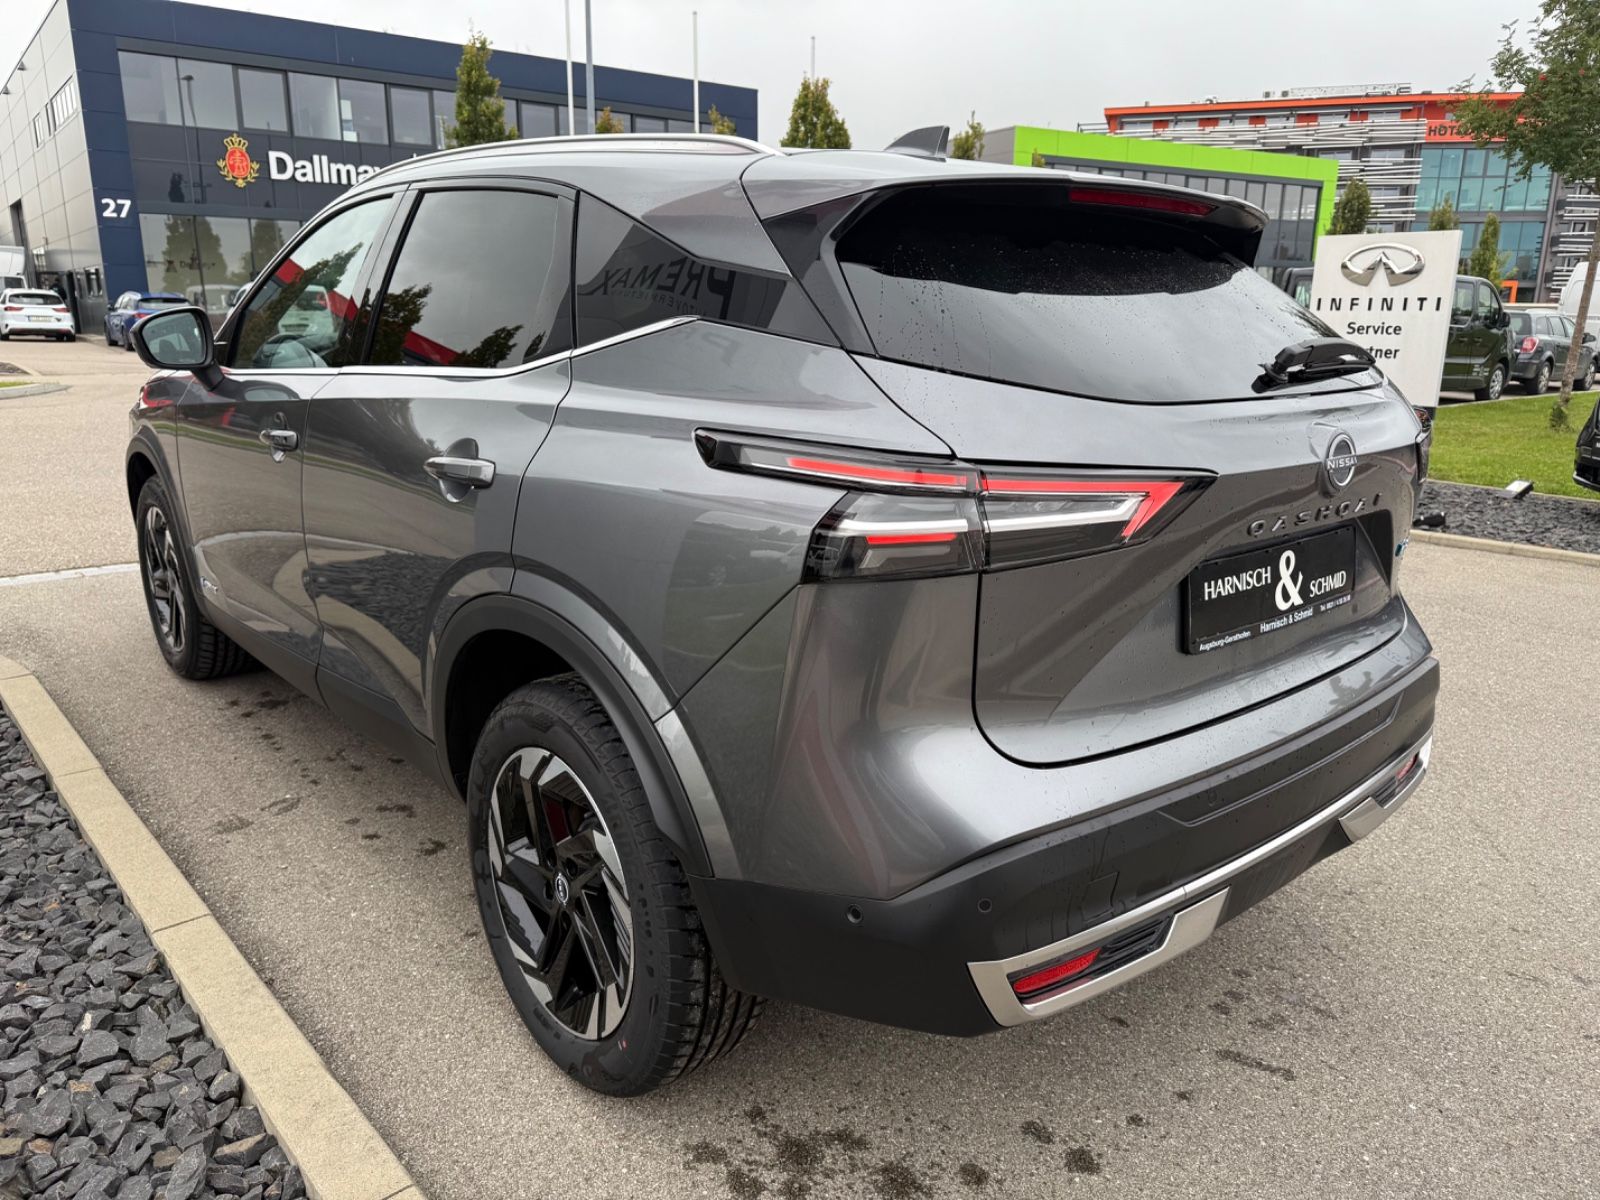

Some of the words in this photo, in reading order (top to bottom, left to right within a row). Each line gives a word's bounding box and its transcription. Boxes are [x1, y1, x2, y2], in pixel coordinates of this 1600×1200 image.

[268, 151, 381, 186] Dallma
[101, 198, 131, 218] 27
[1316, 297, 1442, 312] INFINITI
[1346, 322, 1402, 335] Service
[1367, 346, 1400, 359] tner
[1246, 492, 1382, 537] QASHQAI
[1204, 566, 1272, 600] HARNISCH
[1275, 549, 1304, 611] &
[1309, 570, 1347, 598] SCHMID
[1260, 616, 1287, 633] Harnisch
[1294, 606, 1314, 622] Schmid
